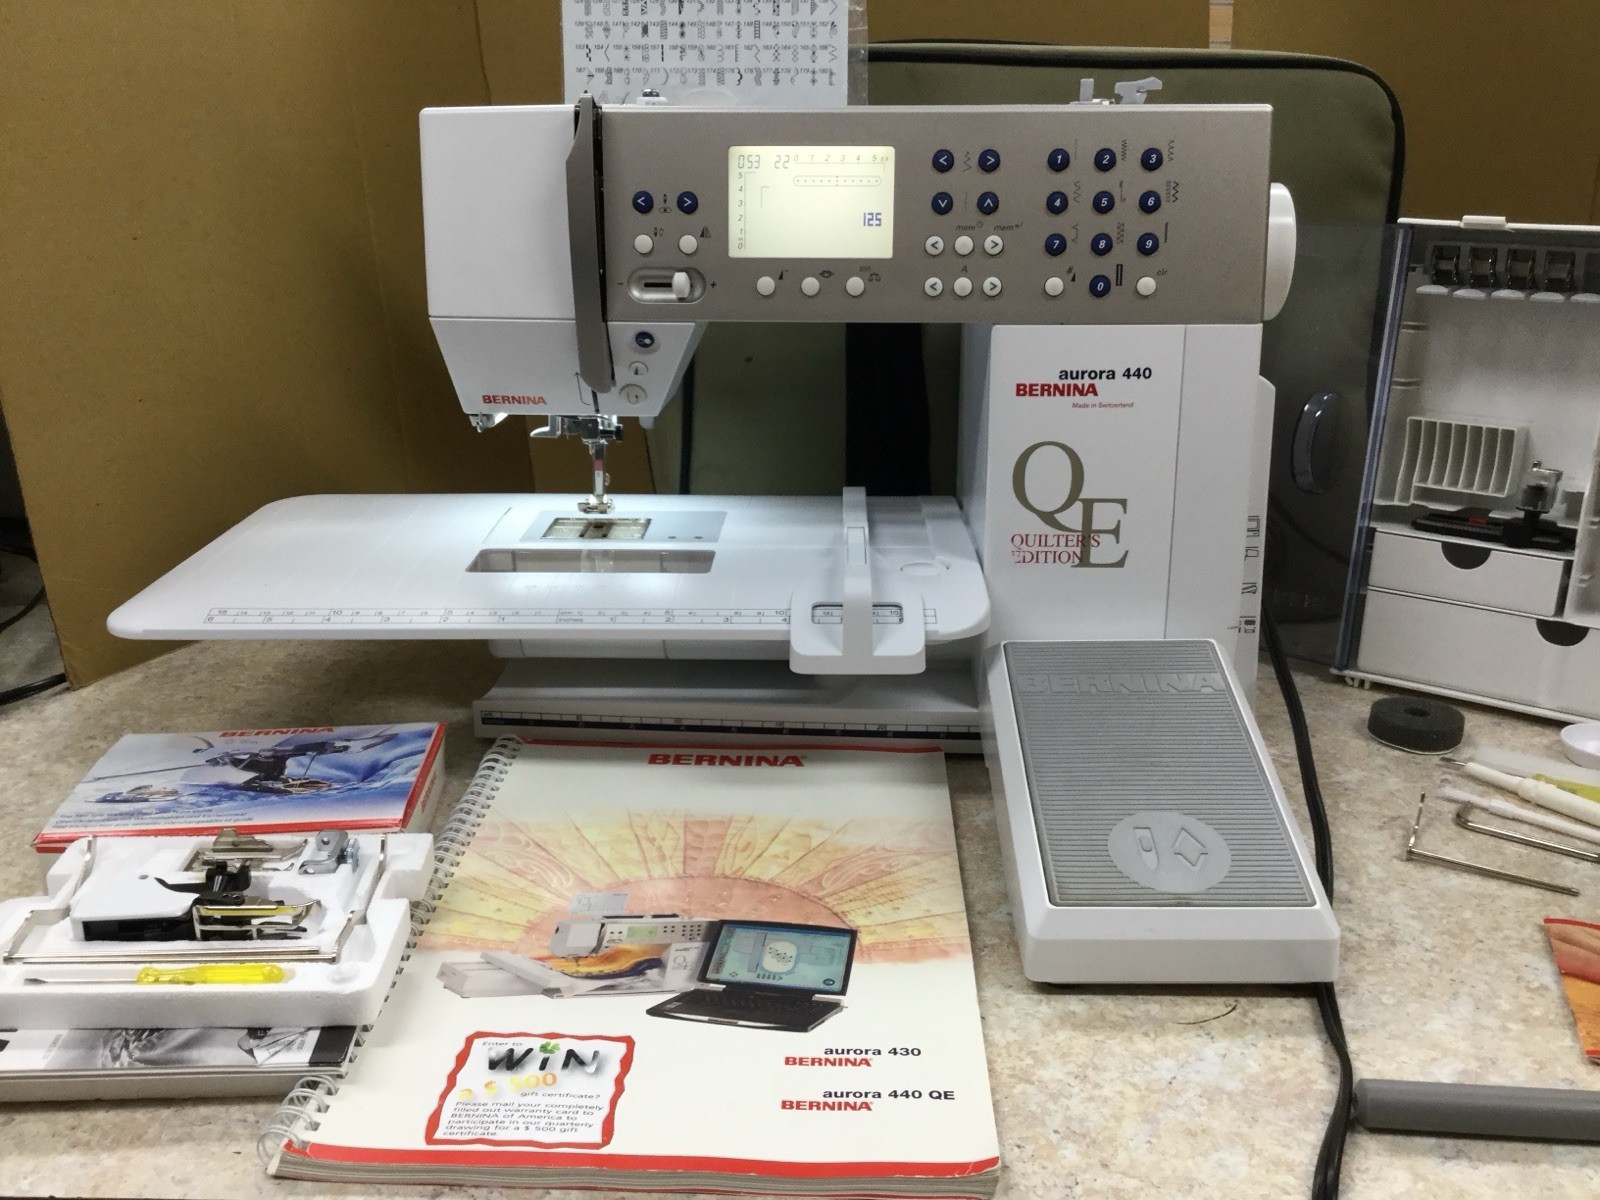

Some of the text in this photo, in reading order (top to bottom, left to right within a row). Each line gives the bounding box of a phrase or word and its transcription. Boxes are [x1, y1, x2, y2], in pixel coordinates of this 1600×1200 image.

[738, 155, 760, 169] 053
[775, 155, 790, 169] 22
[1056, 155, 1156, 164] 1 2 3
[1054, 197, 1154, 206] 4 5 6
[863, 213, 881, 226] 125
[1053, 240, 1152, 249] 7 8 9
[1097, 282, 1104, 291] 0
[1058, 367, 1152, 380] aurora 440
[1016, 383, 1098, 396] BERNINA
[481, 394, 547, 405] BERNINA
[1012, 440, 1129, 568] QE
[647, 753, 805, 767] BERNINA
[824, 1047, 922, 1057] aurora 430
[784, 1056, 872, 1067] BERNINA
[822, 1089, 956, 1101] aurora 440 QE
[545, 1103, 604, 1111] completely
[781, 1100, 873, 1111] BERNINA
